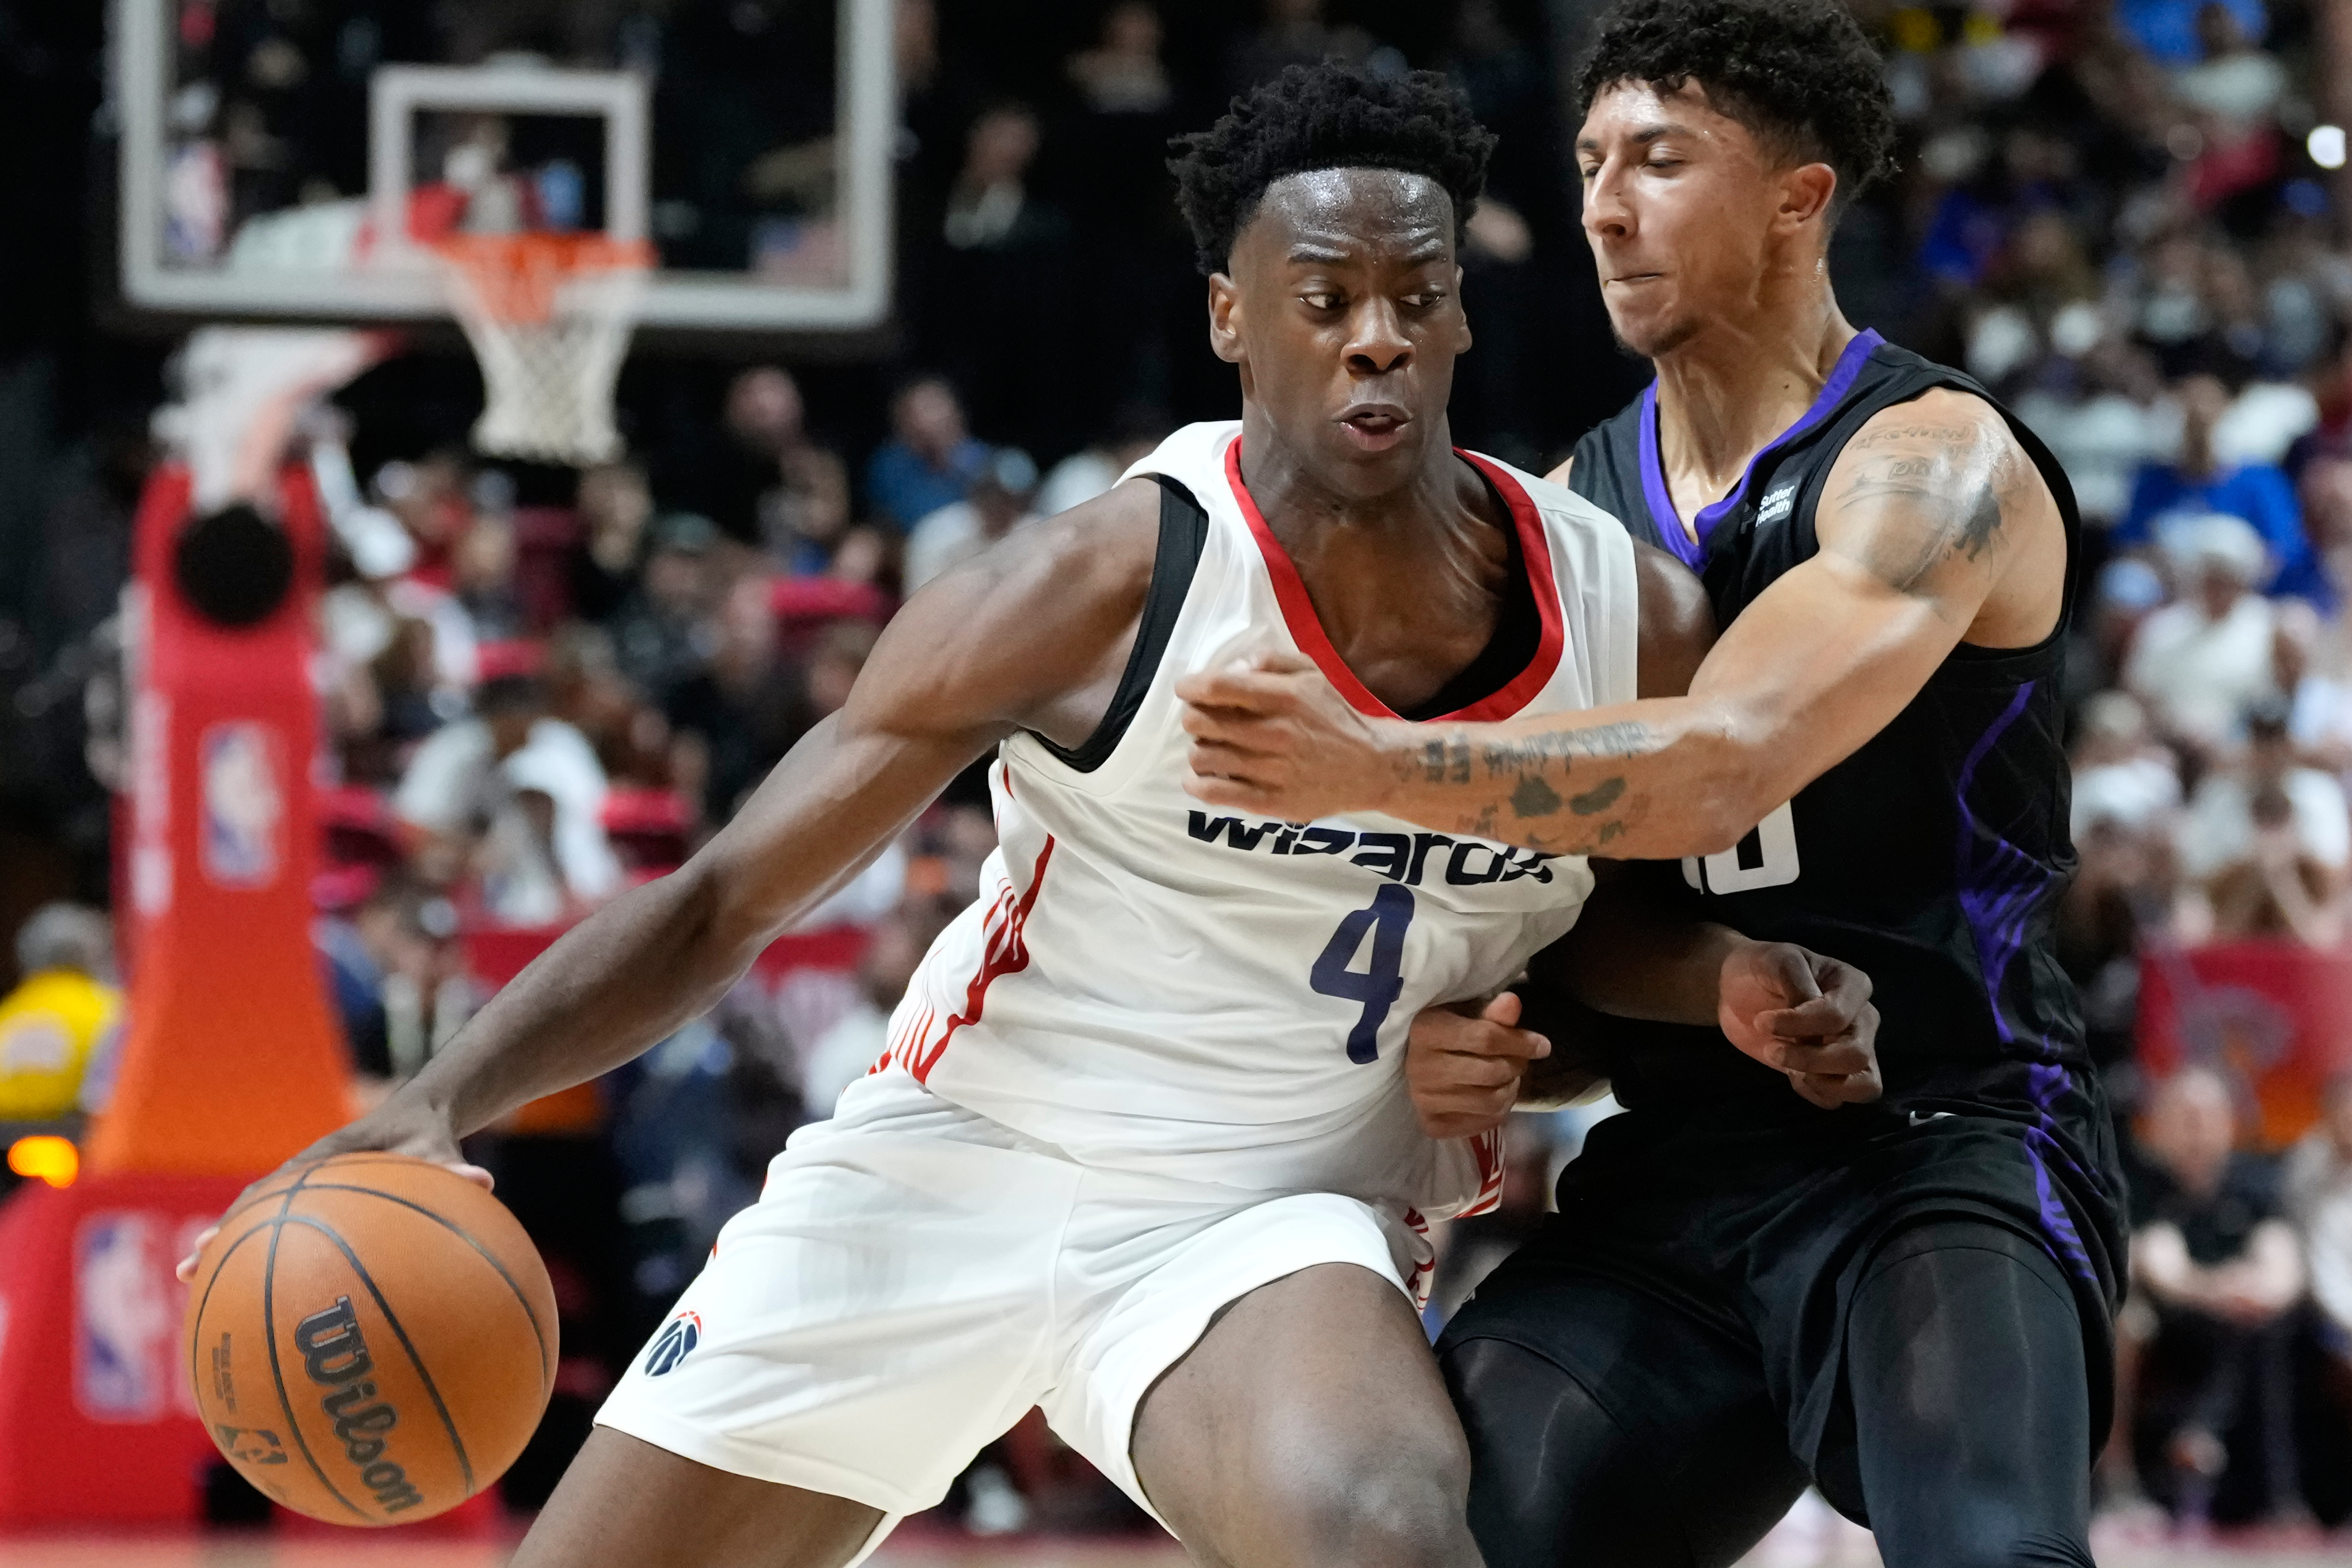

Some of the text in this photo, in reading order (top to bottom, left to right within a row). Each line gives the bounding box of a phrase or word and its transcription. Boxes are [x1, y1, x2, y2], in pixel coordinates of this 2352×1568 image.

[1755, 499, 1790, 527] Health
[1759, 485, 1795, 511] Sutter
[1310, 883, 1415, 1065] 4
[294, 1296, 424, 1513] Wilson
